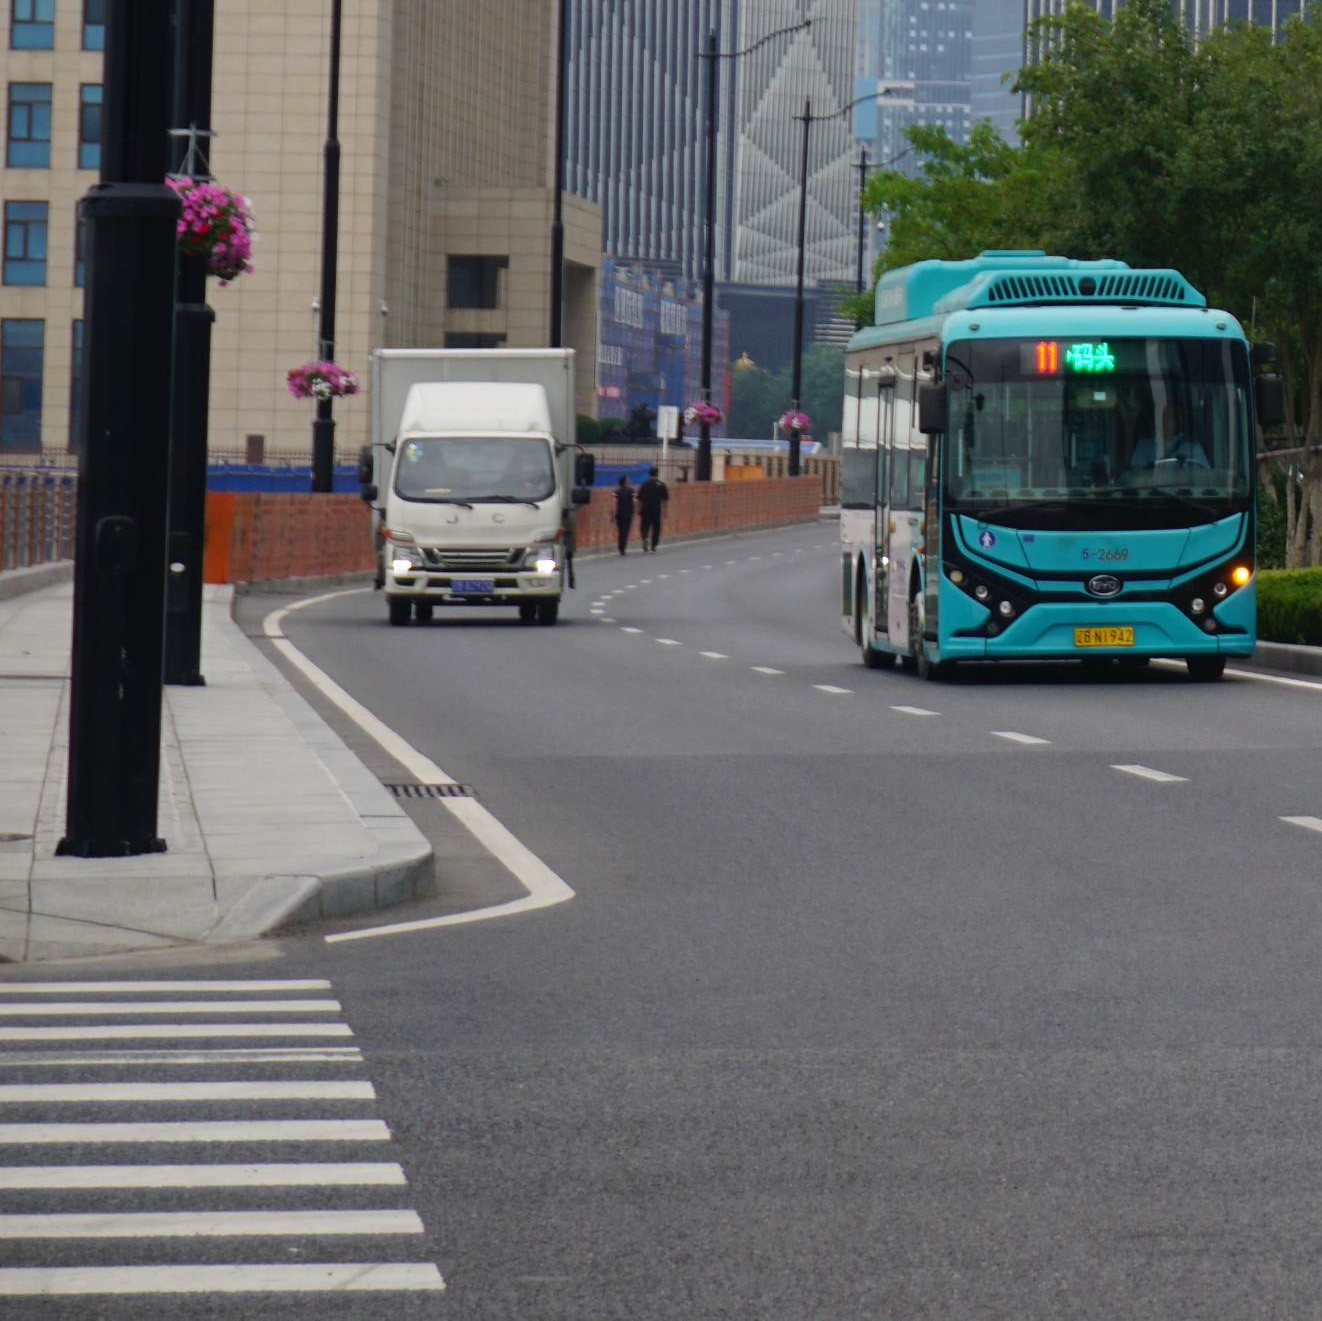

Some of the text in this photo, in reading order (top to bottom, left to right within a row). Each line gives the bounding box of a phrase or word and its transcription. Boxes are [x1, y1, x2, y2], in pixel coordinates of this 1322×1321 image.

[1036, 341, 1058, 373] 11
[1065, 342, 1115, 371] 码头
[1081, 547, 1129, 561] 5-2669
